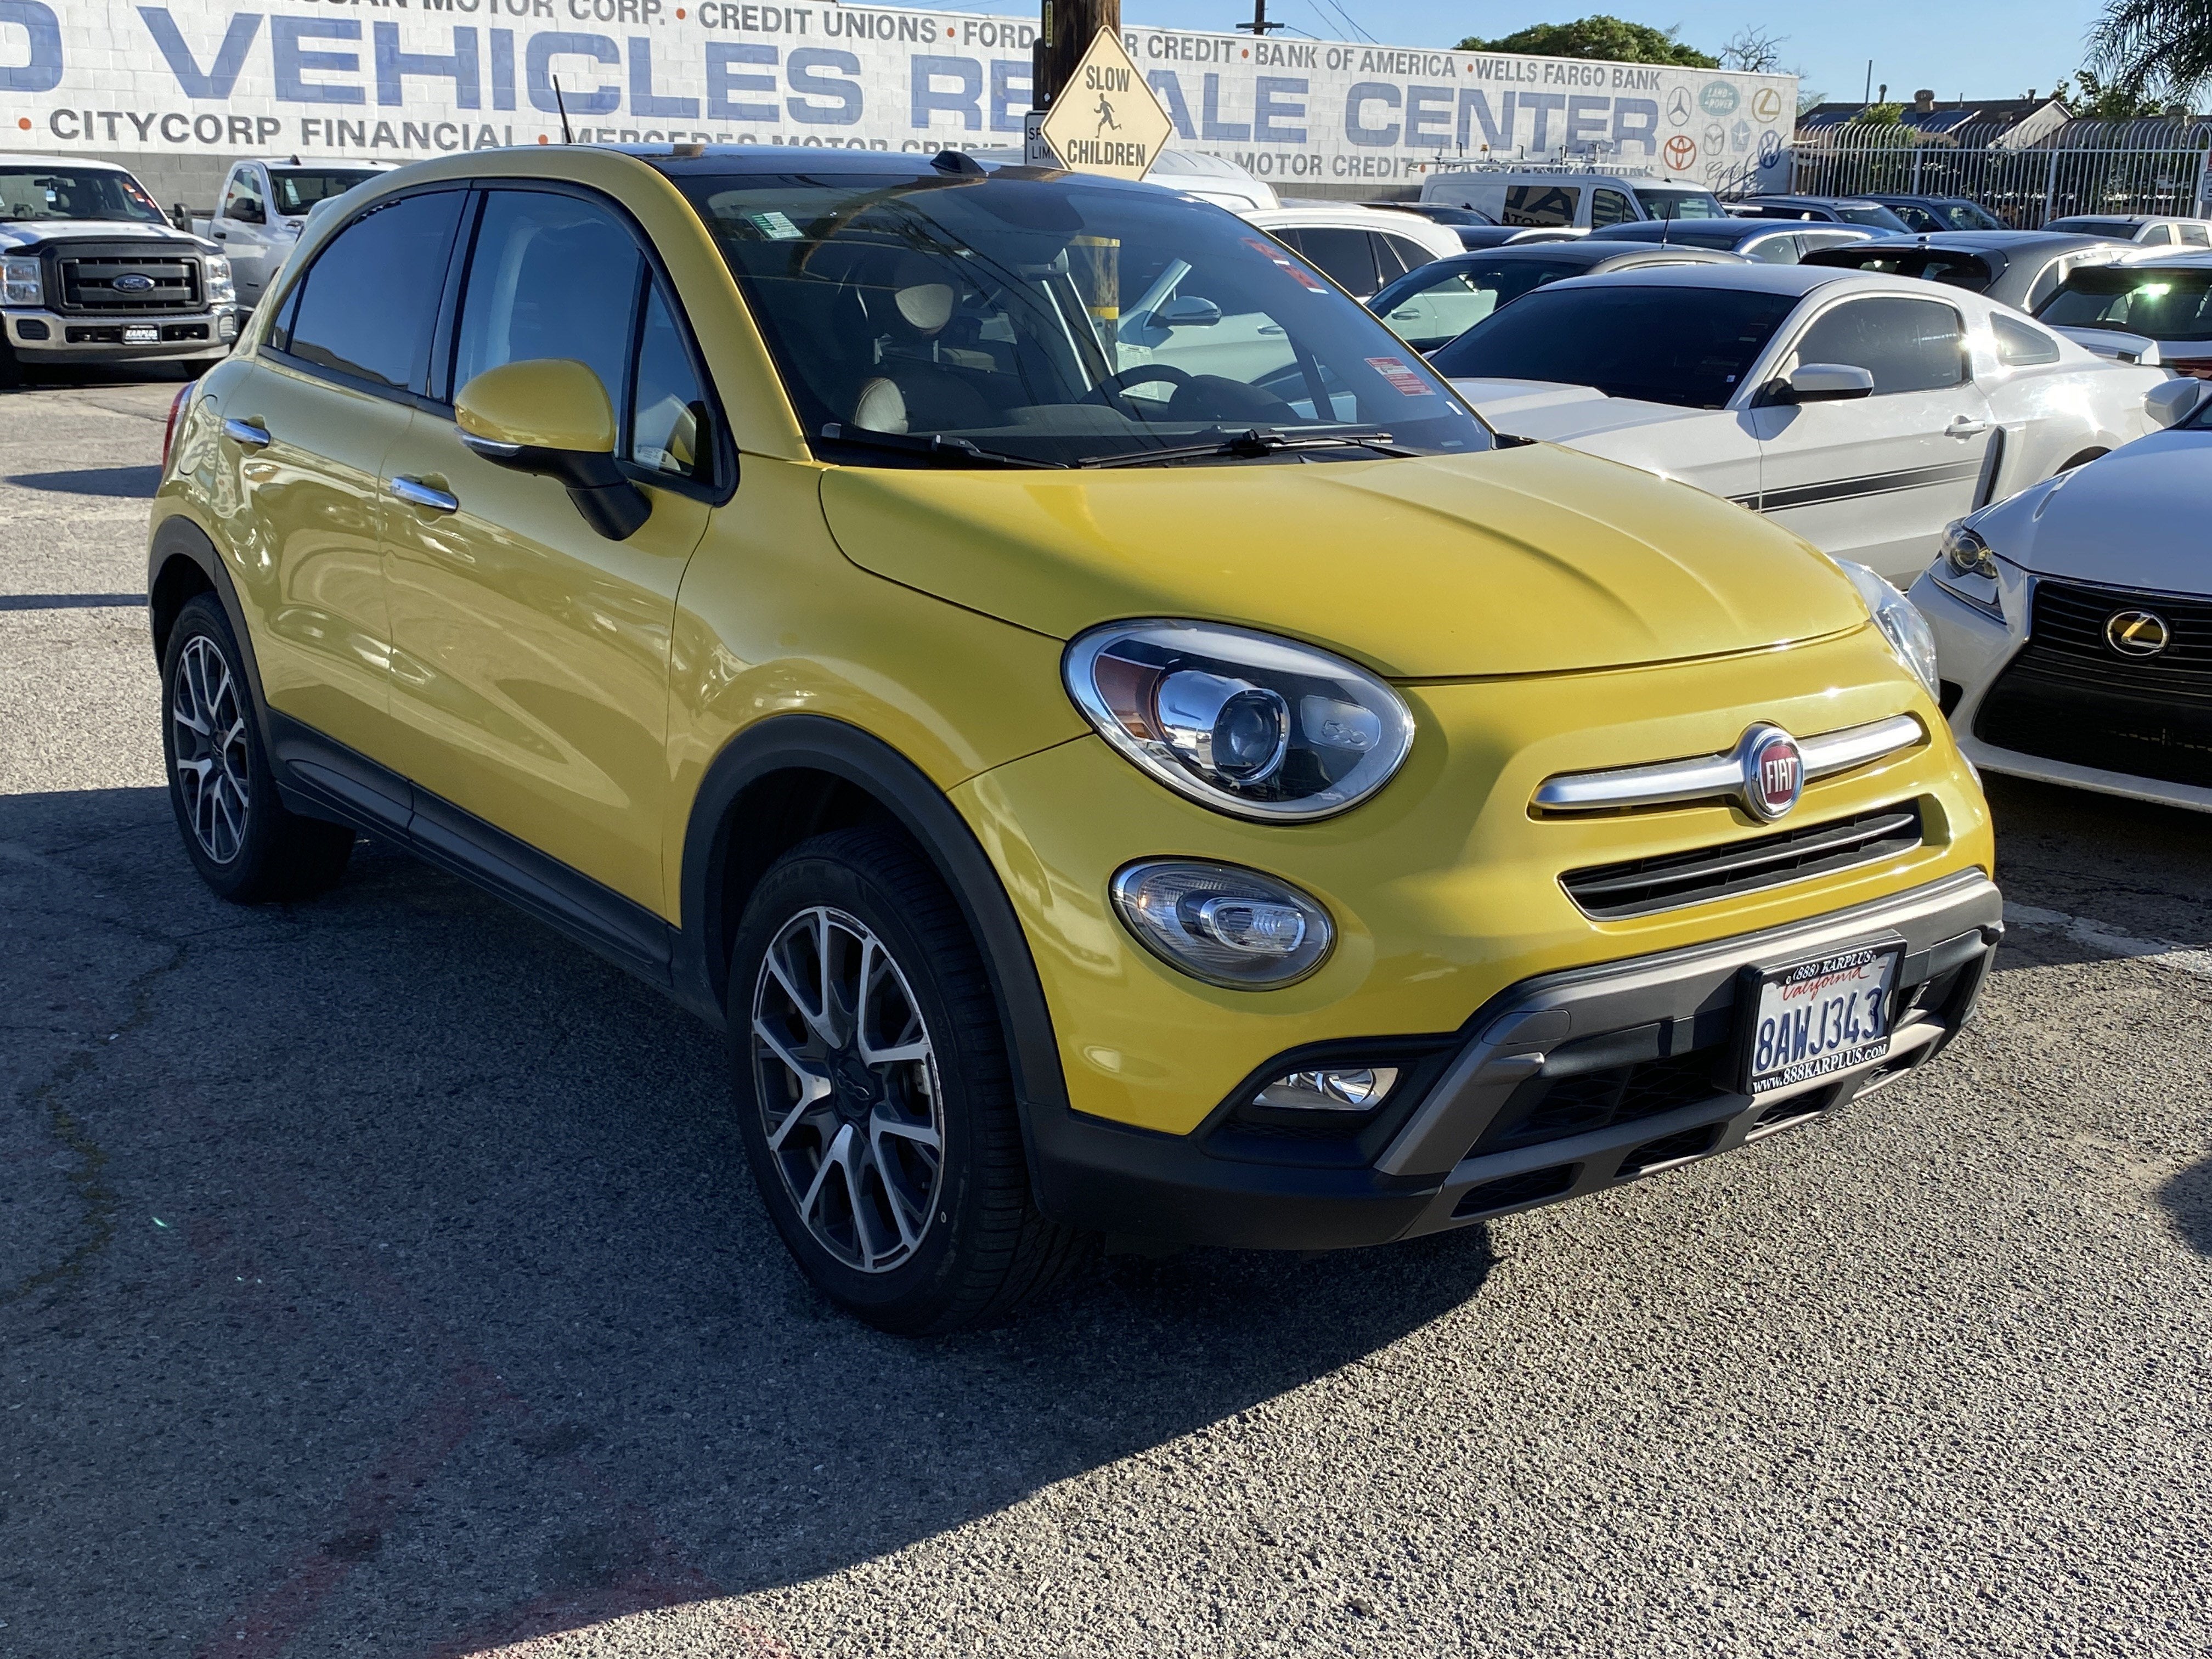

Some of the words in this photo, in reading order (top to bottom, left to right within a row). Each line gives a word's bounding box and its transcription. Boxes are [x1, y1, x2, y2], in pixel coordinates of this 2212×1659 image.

[568, 0, 665, 26] CORP.
[698, 2, 812, 35] CREDIT
[823, 11, 938, 43] UNIONS
[963, 21, 1035, 49] FORD
[1147, 35, 1236, 63] CREDIT
[1255, 42, 1317, 70] BANK
[1326, 47, 1354, 72] OF
[1358, 49, 1456, 78] AMERICA
[1476, 58, 1537, 82] WELLS
[1543, 62, 1605, 87] FARGO
[1612, 68, 1661, 91] BANK
[136, 5, 863, 126] VEHICLES
[910, 53, 1309, 144] REALE
[1345, 82, 1660, 156] CENTER
[1085, 65, 1131, 92] SLOW
[49, 109, 281, 145] CITYCORP
[301, 117, 513, 150] FINANCIAL
[1067, 139, 1146, 167] CHILDREN
[1234, 151, 1323, 176] MOTOR
[1332, 154, 1414, 178] CREDIT
[1321, 719, 1369, 746] 500
[1765, 757, 1799, 794] FIAT
[1792, 962, 1820, 981] (888)
[1820, 950, 1874, 974] KARPLUS
[1783, 966, 1870, 1001] California
[1756, 987, 1883, 1071] 8AWJ343
